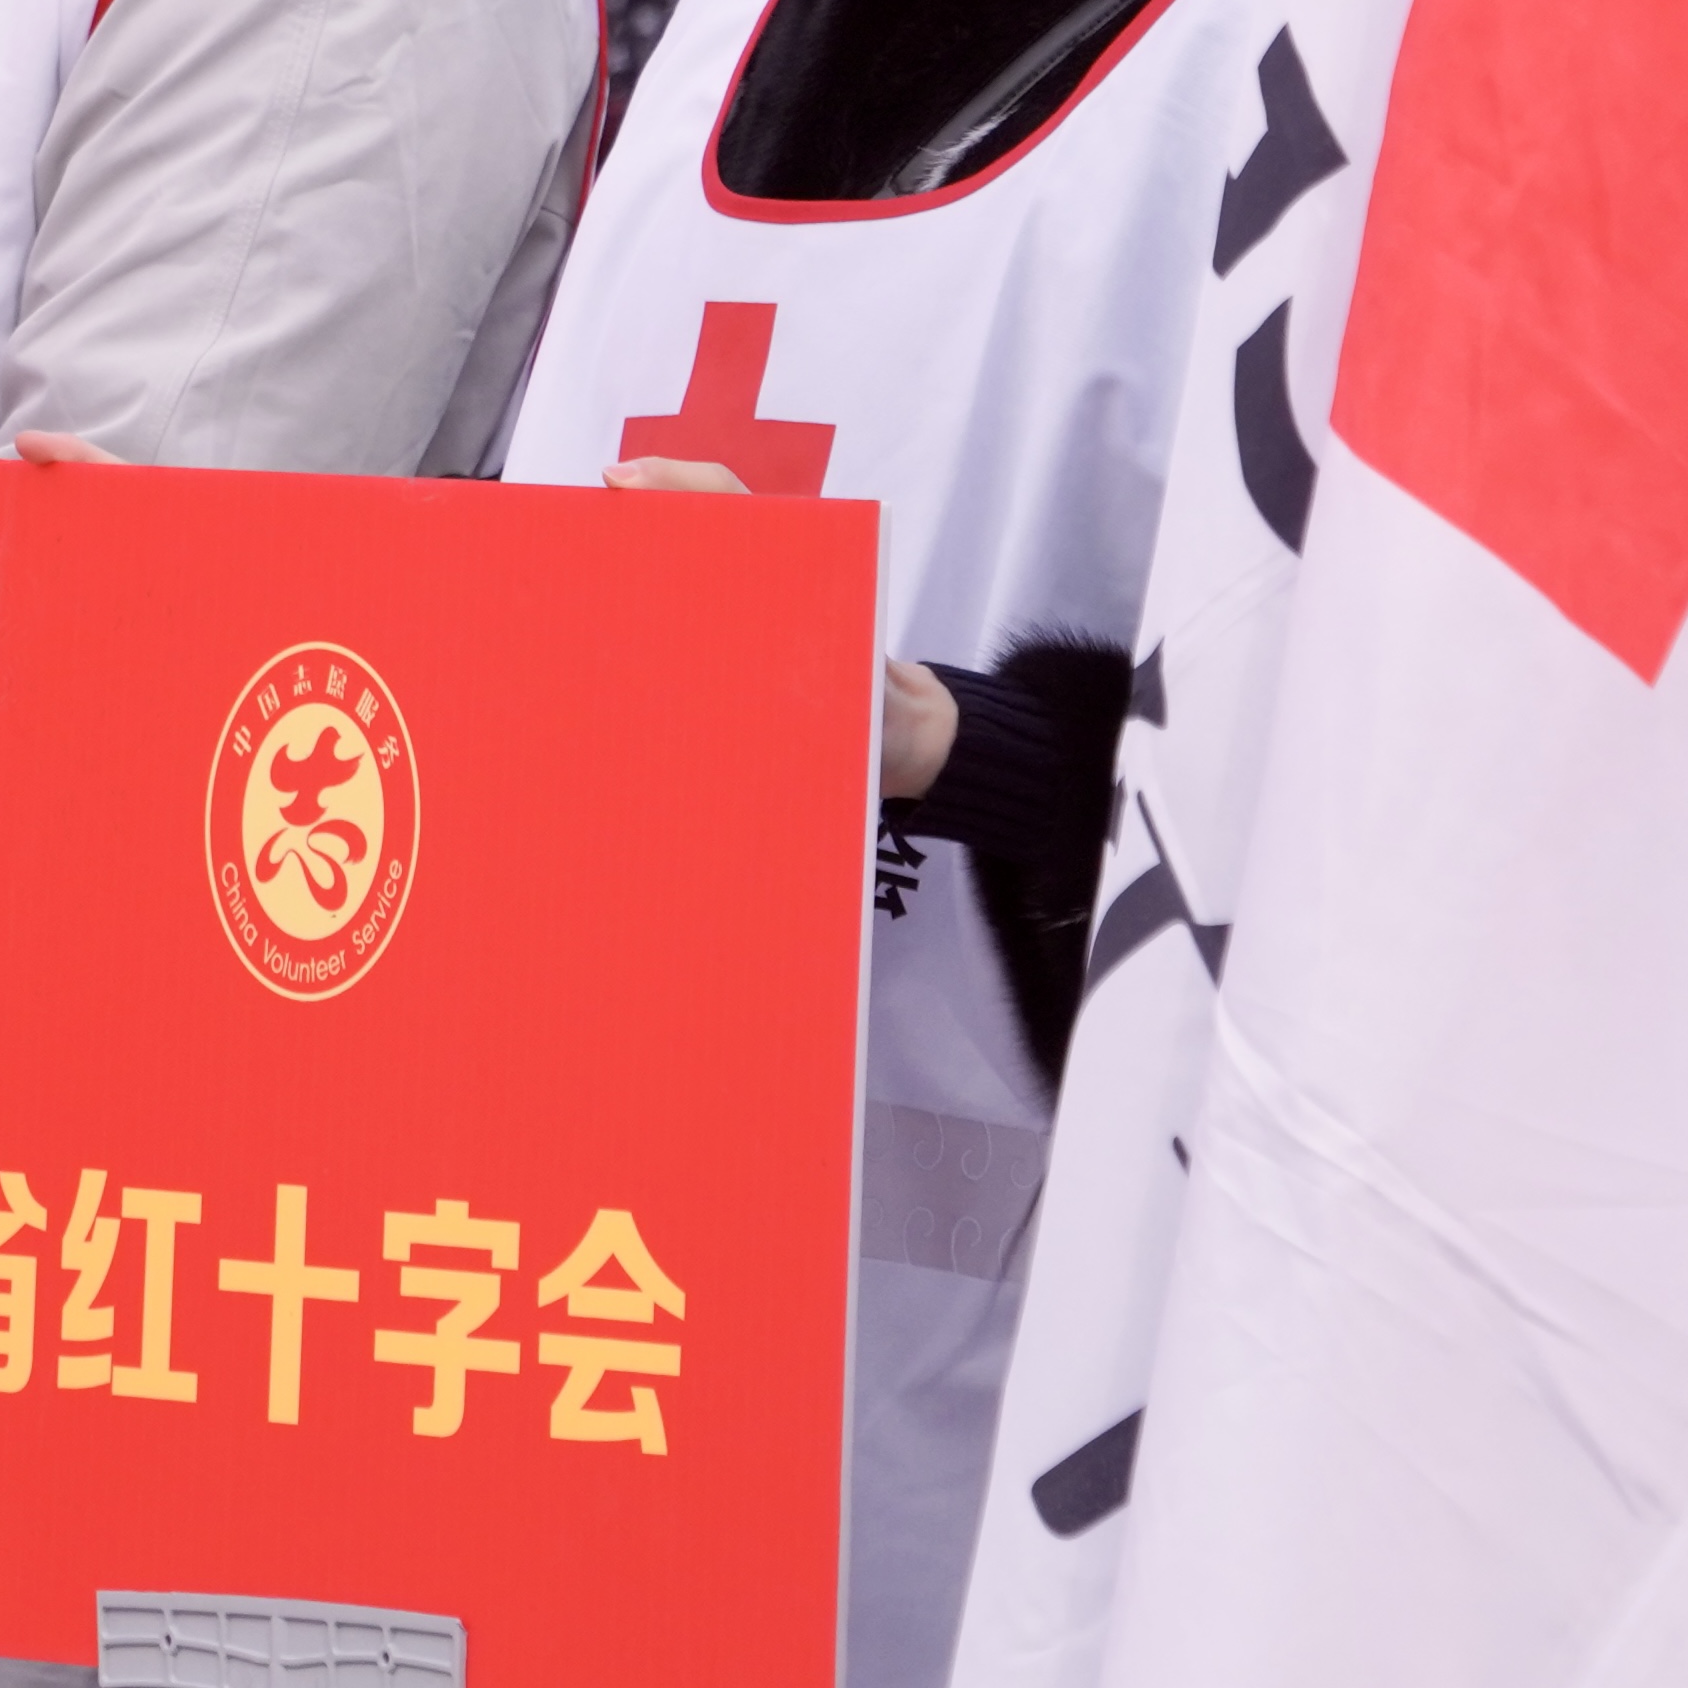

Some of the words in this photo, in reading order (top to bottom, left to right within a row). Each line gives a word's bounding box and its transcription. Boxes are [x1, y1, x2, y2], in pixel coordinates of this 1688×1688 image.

[232, 664, 400, 770] 中国志愿服务
[221, 862, 259, 947] China
[263, 938, 347, 984] Volunteer
[351, 859, 404, 955] Service
